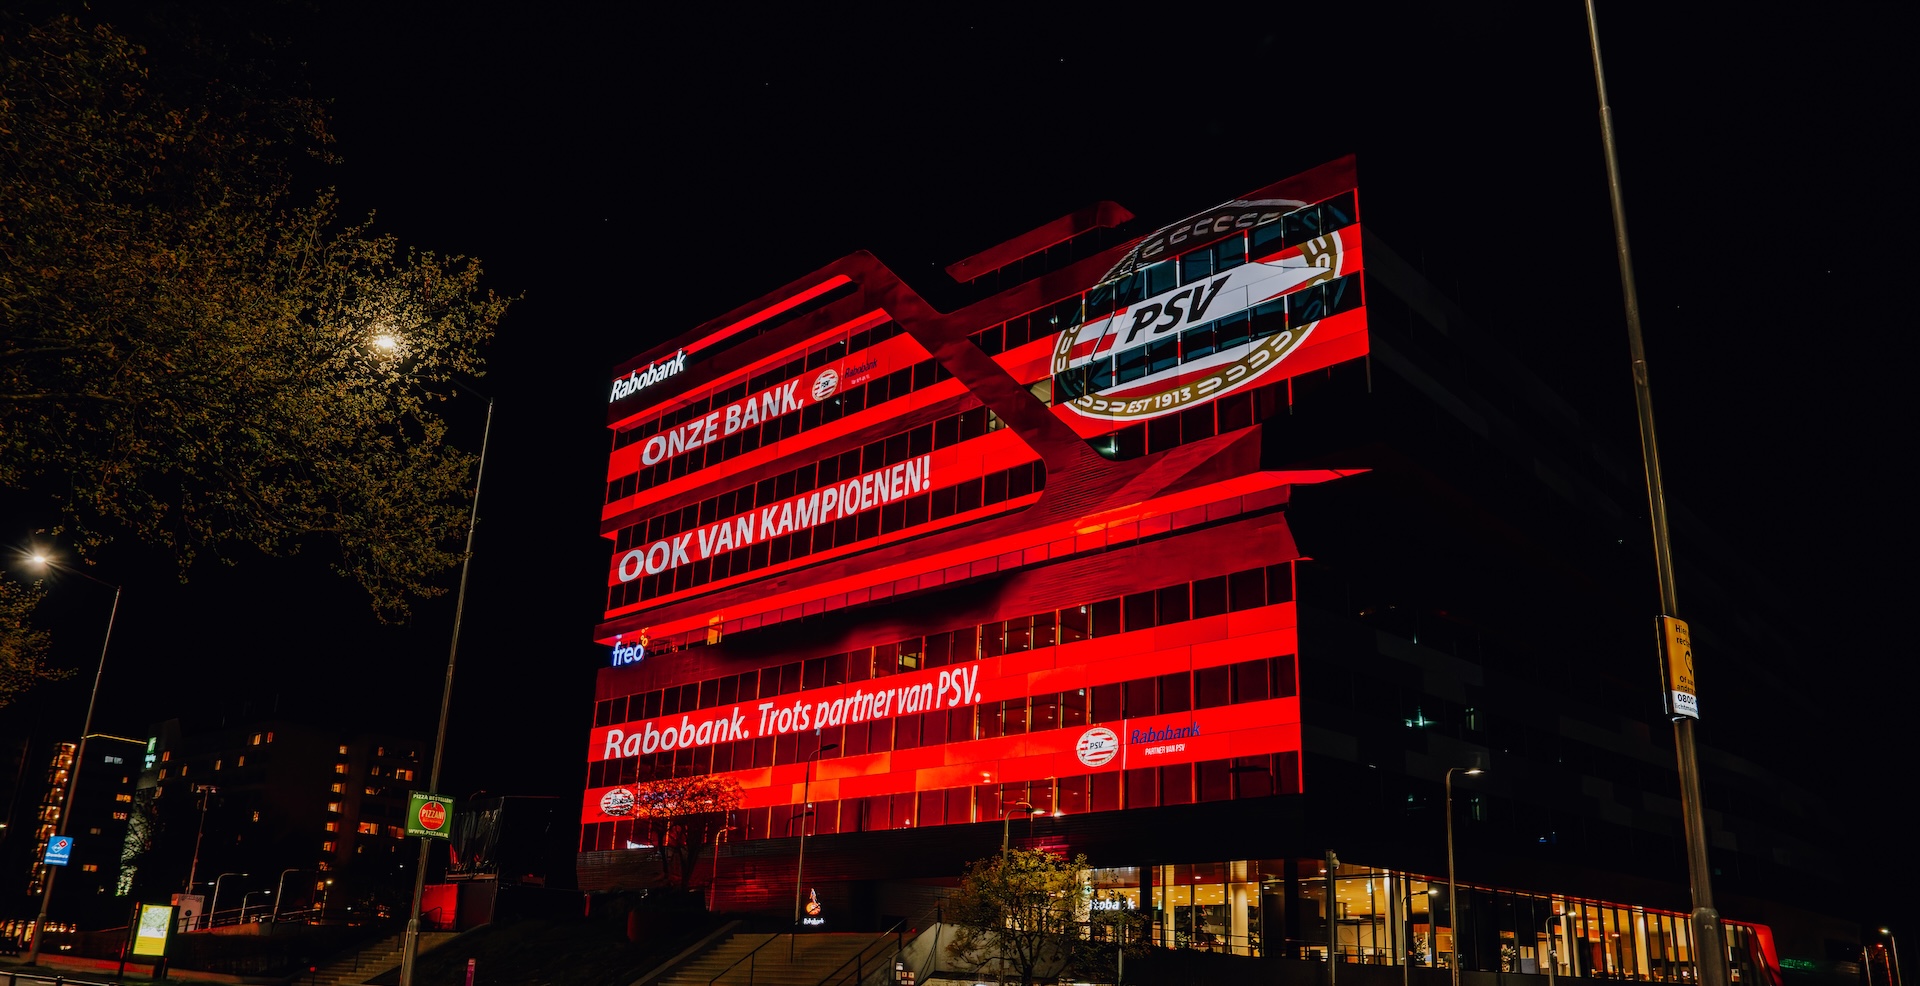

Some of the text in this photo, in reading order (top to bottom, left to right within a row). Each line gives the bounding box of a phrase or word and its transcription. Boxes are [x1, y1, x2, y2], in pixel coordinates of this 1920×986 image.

[1125, 273, 1232, 344] PSV
[610, 350, 686, 403] Rabobank
[1126, 387, 1191, 413] EST 1913
[641, 379, 804, 465] ONZE BANK,
[618, 455, 931, 583] OOK VAN KAMPIOENEN!
[613, 641, 644, 666] freo
[604, 665, 981, 760] Rabobank. Trots partner van PSV.
[1089, 740, 1104, 750] PSV
[1131, 721, 1200, 745] Rabobank
[1145, 743, 1186, 756] PARTNER VAN PSV
